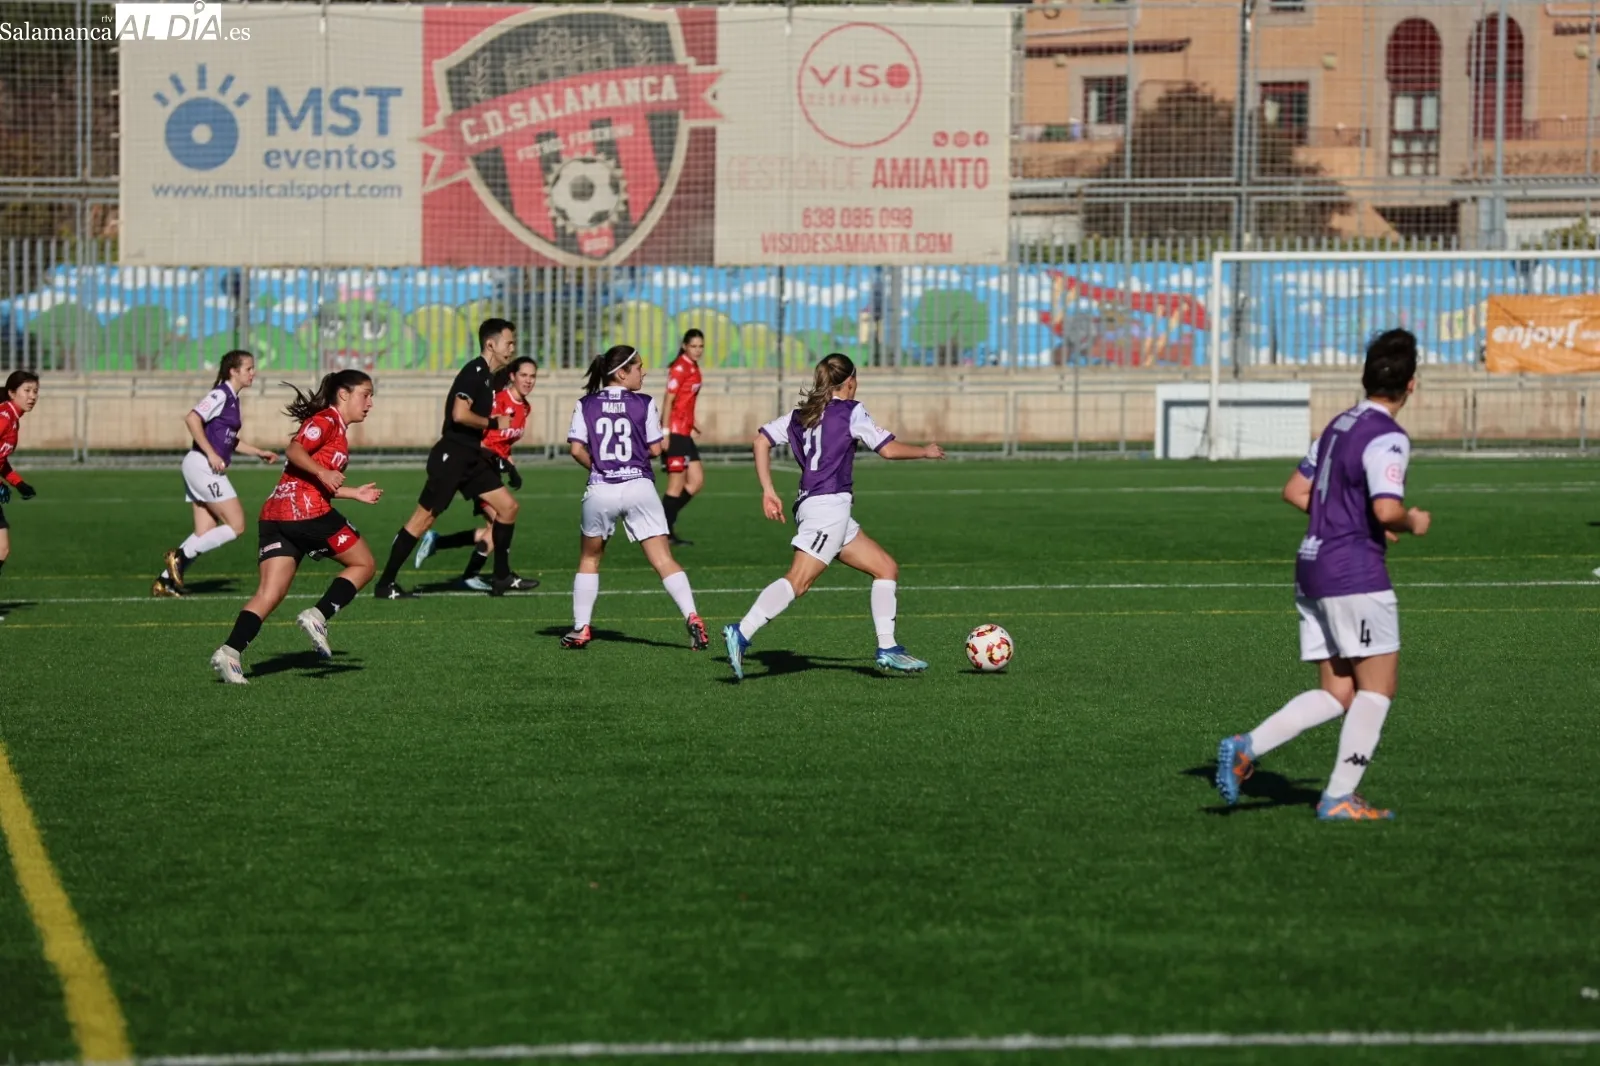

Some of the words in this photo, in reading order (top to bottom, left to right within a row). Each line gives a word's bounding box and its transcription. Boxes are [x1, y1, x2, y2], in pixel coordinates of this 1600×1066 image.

[809, 63, 911, 89] VISO
[266, 87, 404, 137] MST
[263, 144, 397, 170] eventos
[872, 157, 989, 189] AMIANTO
[152, 180, 403, 200] www.musicalsport.com
[802, 207, 836, 229] 638
[596, 417, 633, 462] 23
[207, 482, 223, 499] 12
[810, 530, 829, 554] 11
[1360, 619, 1372, 648] 4
